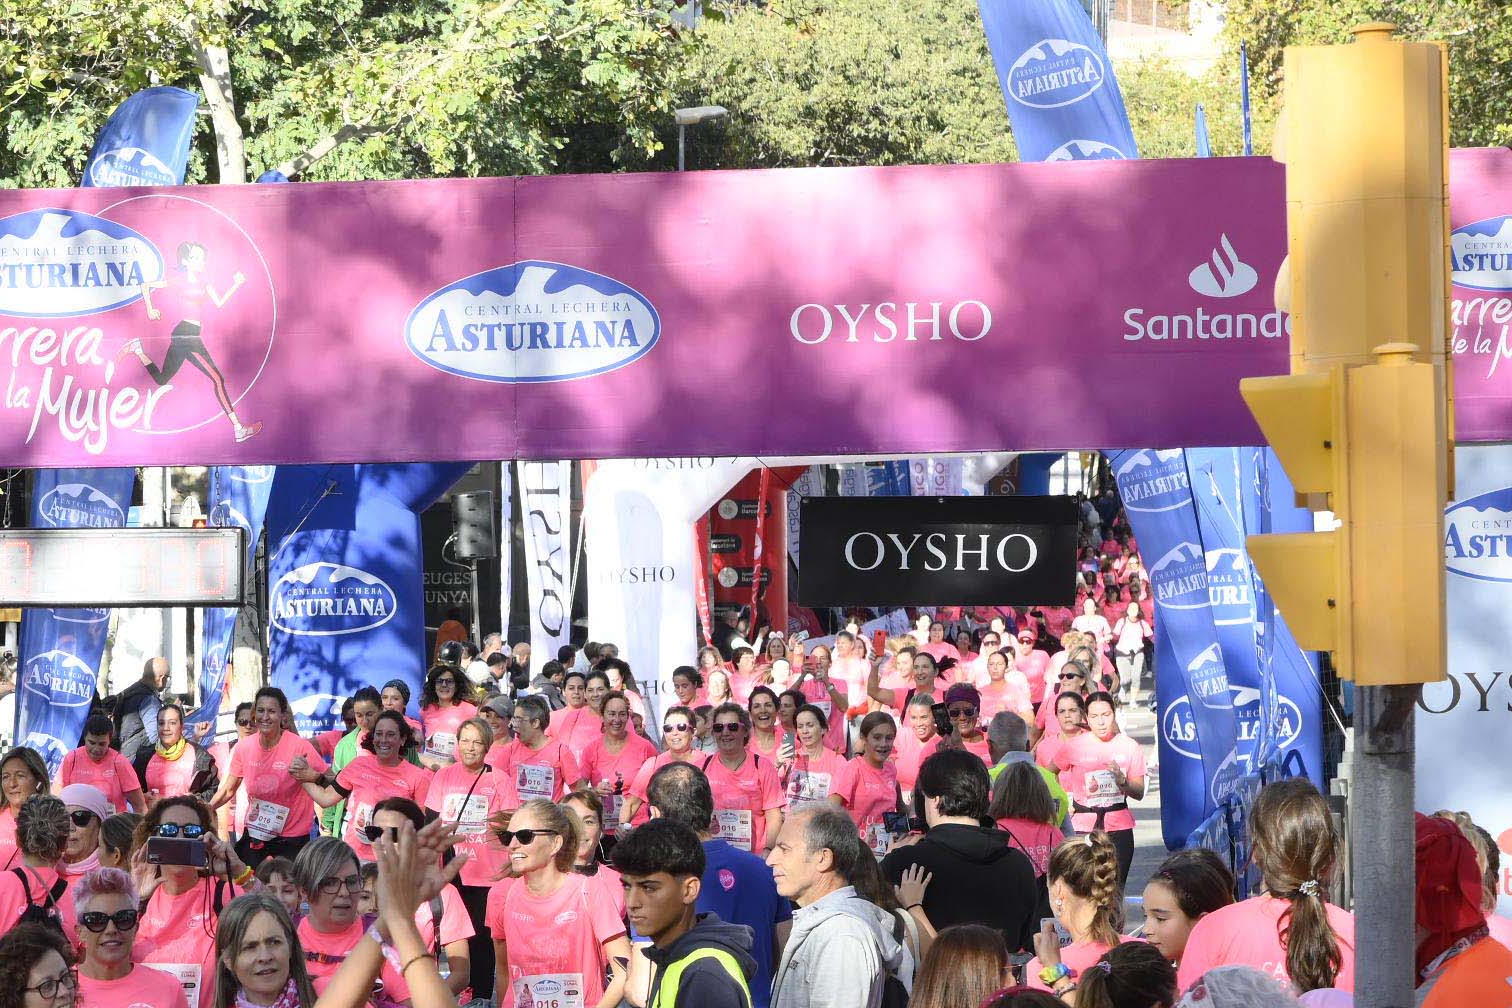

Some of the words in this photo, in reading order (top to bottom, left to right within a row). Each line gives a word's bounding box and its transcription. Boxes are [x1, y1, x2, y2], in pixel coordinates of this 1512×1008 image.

[66, 243, 139, 257] LECHERA
[463, 304, 534, 319] CENTRAL
[543, 300, 633, 316] LECHERA
[789, 298, 993, 346] OYSHO
[424, 305, 638, 353] ASTURIANA
[5, 374, 31, 410] la
[25, 362, 176, 456] Mujer
[844, 531, 1039, 573] OYSHO
[274, 592, 388, 618] ASTURIANA
[288, 587, 329, 597] CENTRAL
